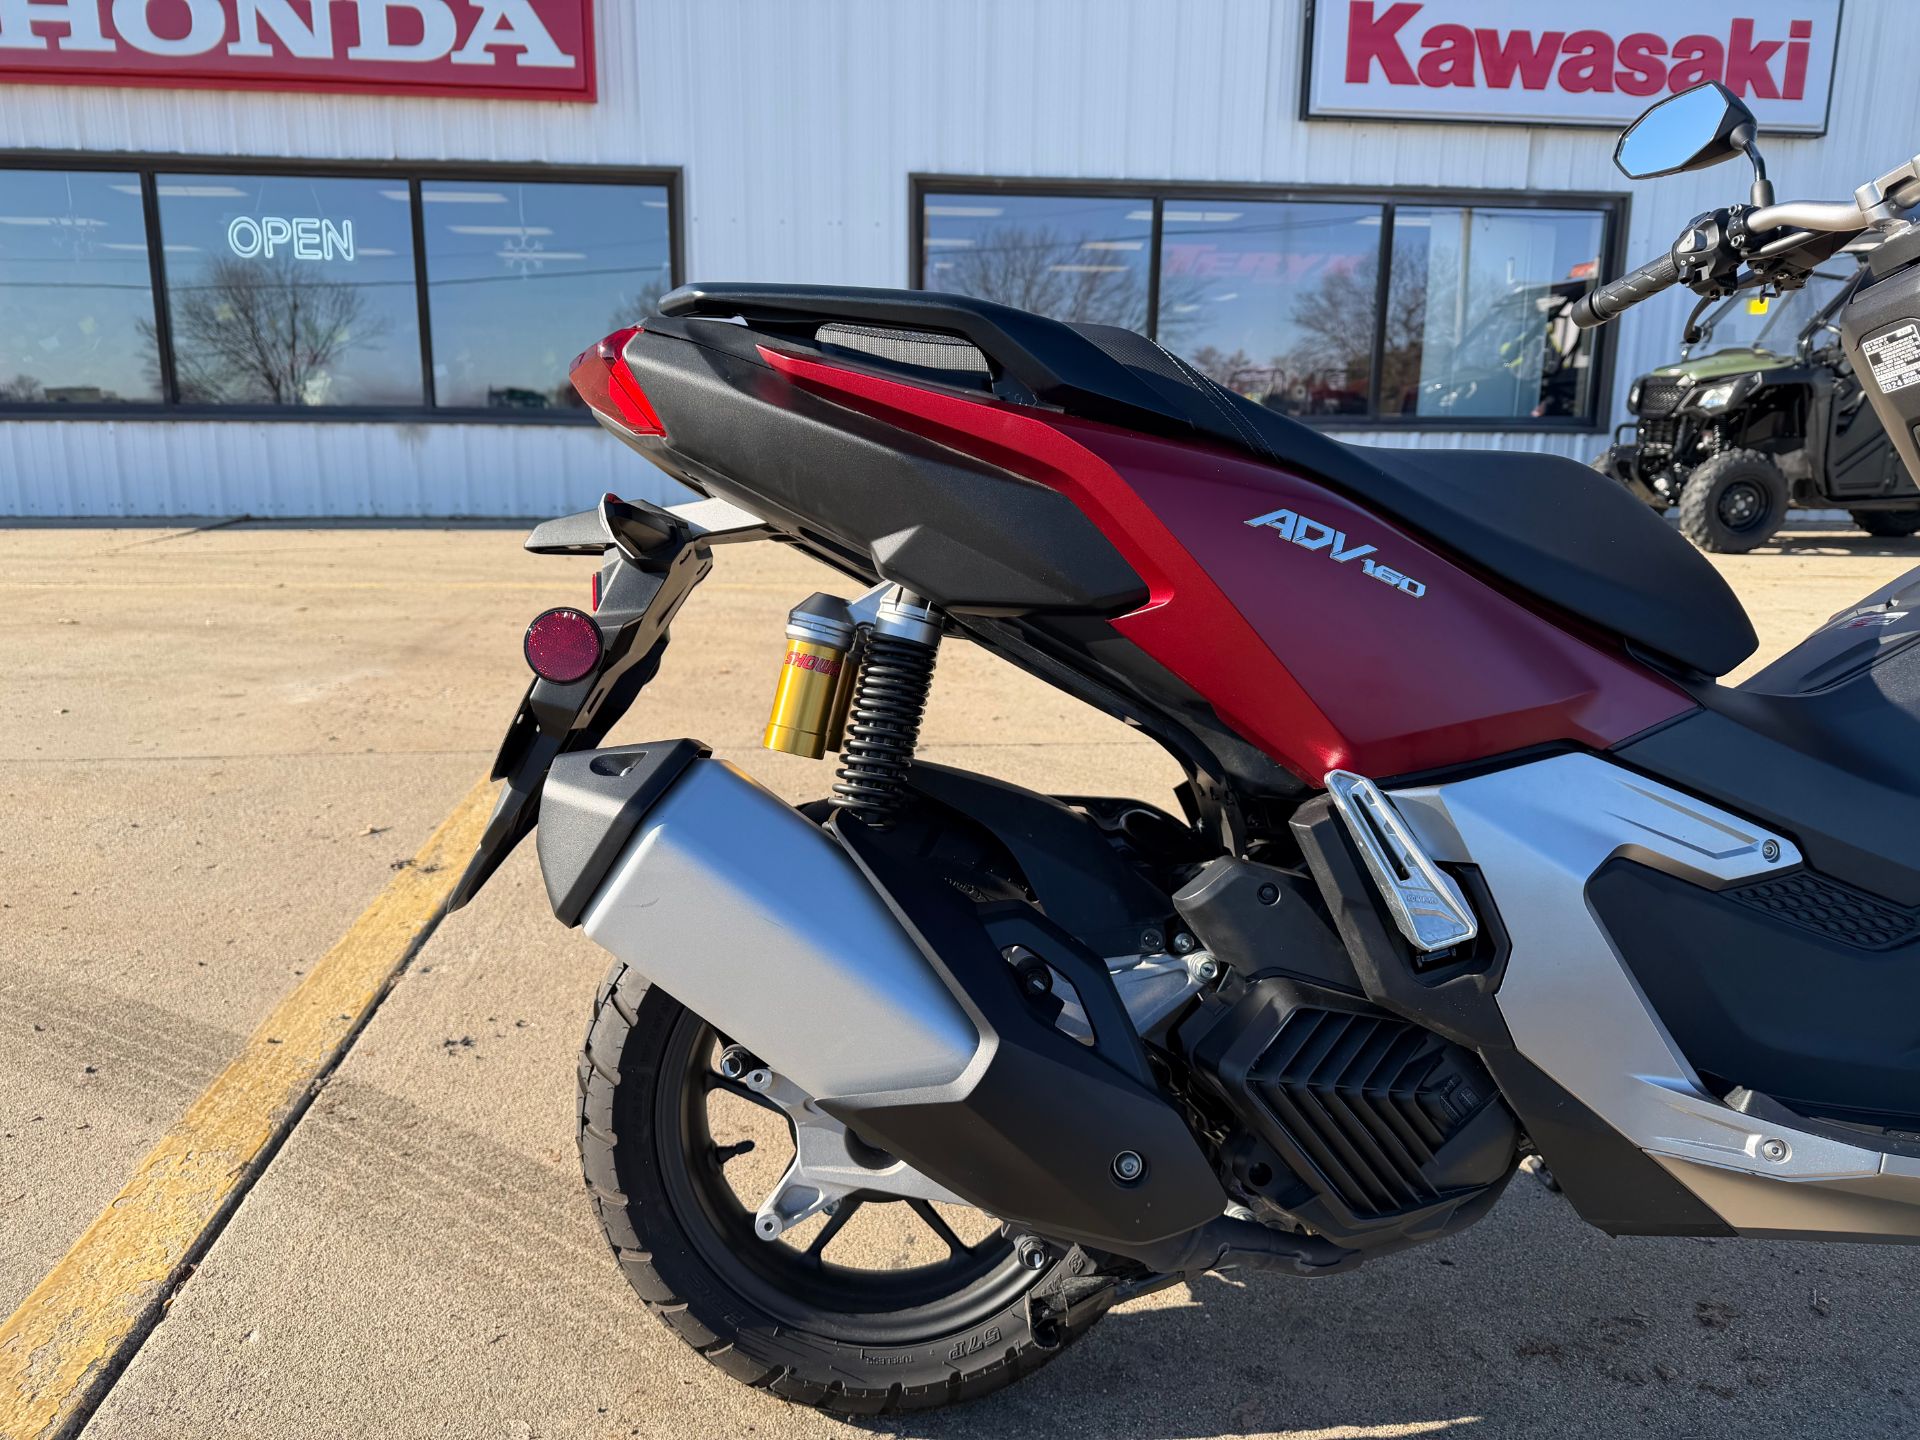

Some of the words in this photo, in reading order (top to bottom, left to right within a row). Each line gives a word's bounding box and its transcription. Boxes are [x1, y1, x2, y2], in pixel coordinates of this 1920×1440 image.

[0, 0, 575, 68] HONDA
[1345, 1, 1812, 100] Kawasaki
[228, 216, 355, 262] OPEN
[784, 651, 841, 677] SHOWA
